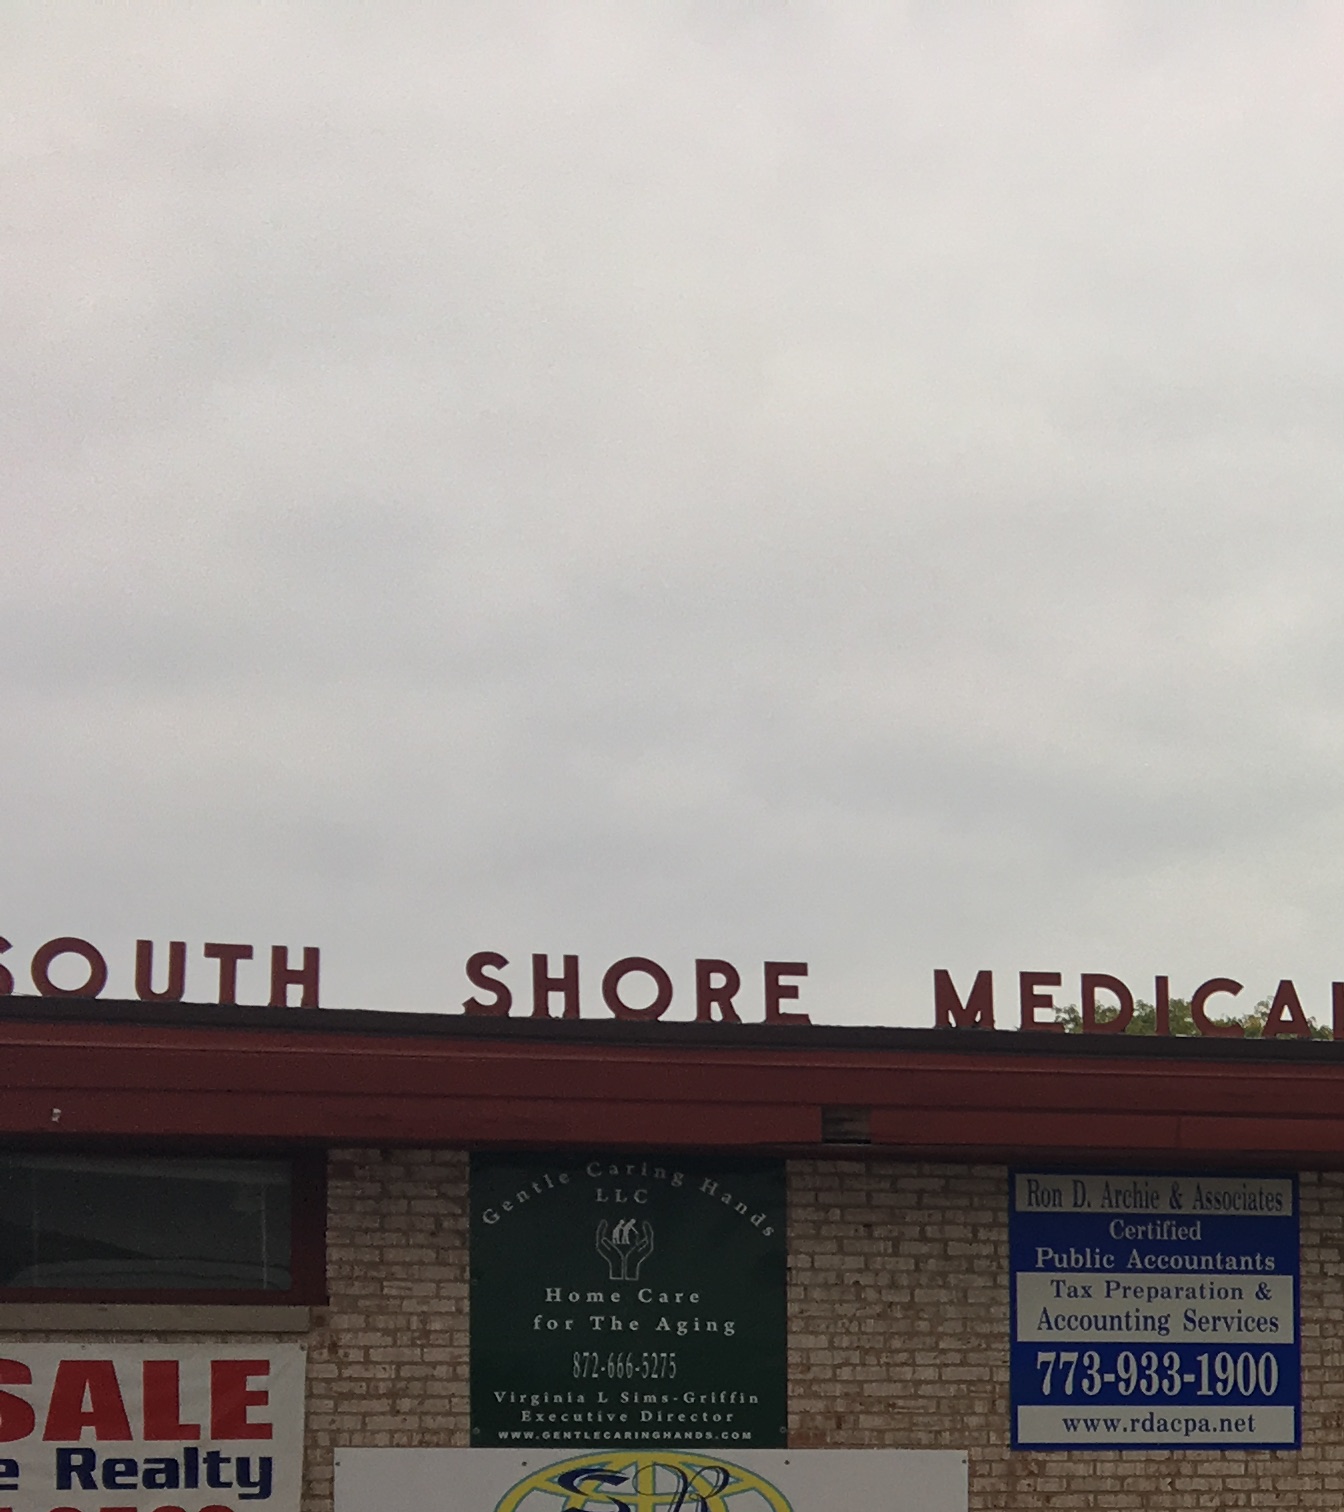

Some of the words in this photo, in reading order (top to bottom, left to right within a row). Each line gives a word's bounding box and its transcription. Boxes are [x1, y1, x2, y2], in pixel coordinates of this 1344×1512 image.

[0, 936, 321, 1009] OUTH
[463, 951, 811, 1025] SHORE
[482, 1171, 570, 1226] Gentle
[586, 1161, 685, 1187] Caring
[699, 1177, 775, 1237] Hands
[595, 1188, 649, 1204] LLC
[1027, 1179, 1063, 1208] Ron
[1072, 1180, 1091, 1209] D.
[1100, 1180, 1159, 1210] Archie
[1169, 1181, 1183, 1210] &
[1192, 1182, 1283, 1212] Associates
[1109, 1219, 1202, 1241] Certified
[1035, 1247, 1115, 1269] Public
[1126, 1249, 1275, 1271] Accountants
[545, 1287, 621, 1303] Home
[637, 1288, 701, 1303] Care
[1051, 1279, 1093, 1299] Tax
[1104, 1280, 1244, 1303] Preparation
[1255, 1282, 1272, 1300] &
[533, 1315, 574, 1331] for
[589, 1315, 641, 1331] The
[655, 1316, 736, 1337] Aging
[1037, 1307, 1171, 1336] Accounting
[1183, 1308, 1279, 1333] Services
[572, 1351, 677, 1379] 872-666-5275
[1036, 1351, 1279, 1396] 773-933-1900
[494, 1391, 585, 1407] Virginia
[597, 1391, 608, 1403] L
[620, 1391, 759, 1405] Sims-Griffin
[521, 1410, 628, 1423] Executive
[640, 1410, 734, 1423] Director
[1062, 1412, 1256, 1437] www.rdacpa.net
[498, 1431, 752, 1440] WWW.GENTLECARINGHANDS.COM
[56, 1446, 273, 1500] Realty
